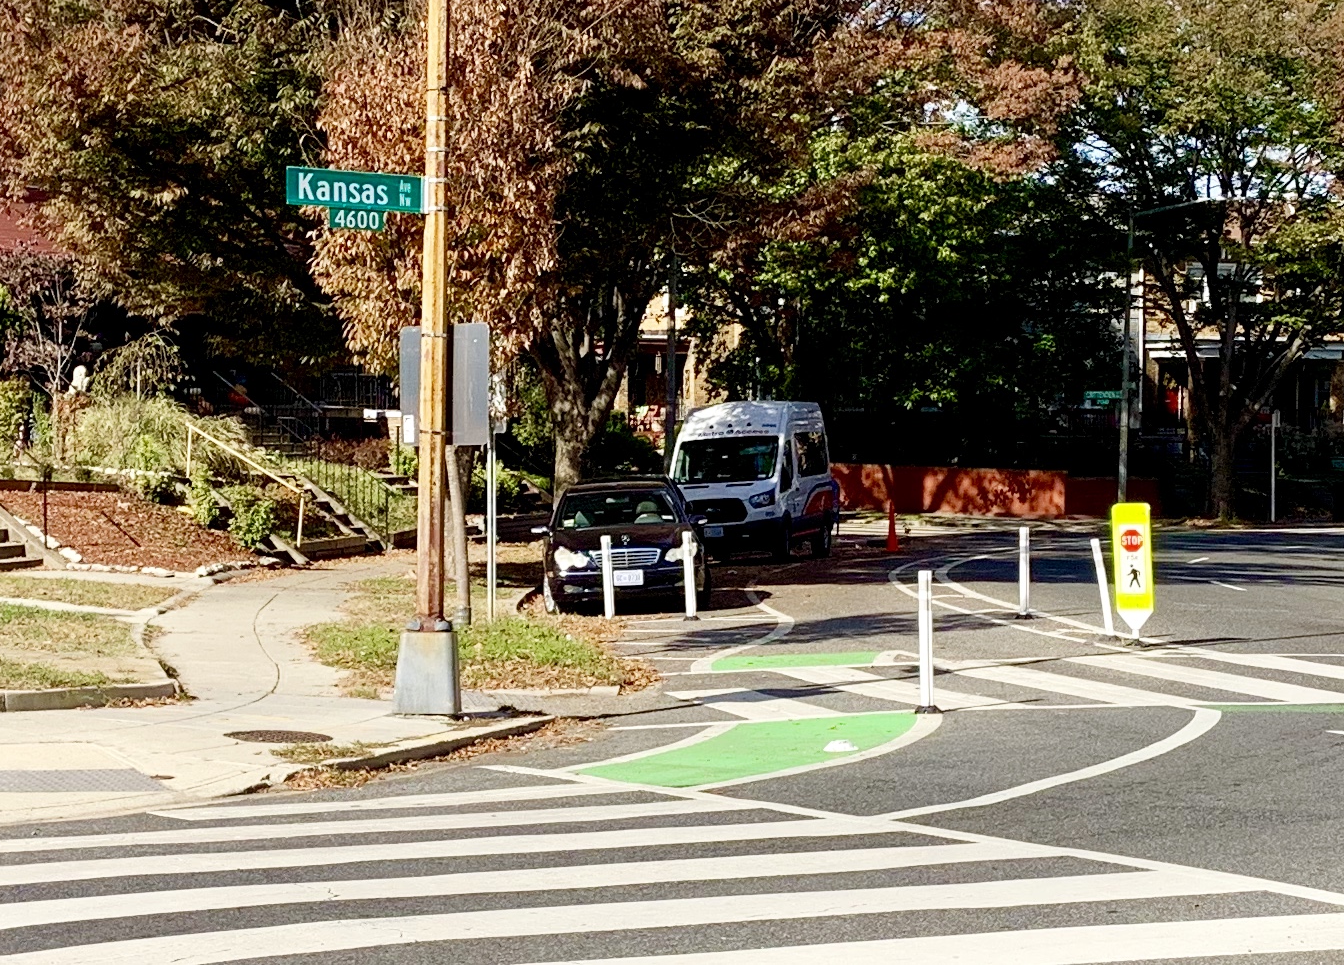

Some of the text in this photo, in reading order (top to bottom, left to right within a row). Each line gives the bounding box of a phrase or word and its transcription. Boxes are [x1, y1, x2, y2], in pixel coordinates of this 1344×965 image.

[298, 172, 411, 205] Kansas Ave
[334, 209, 379, 229] 4600
[1121, 535, 1143, 545] STOP
